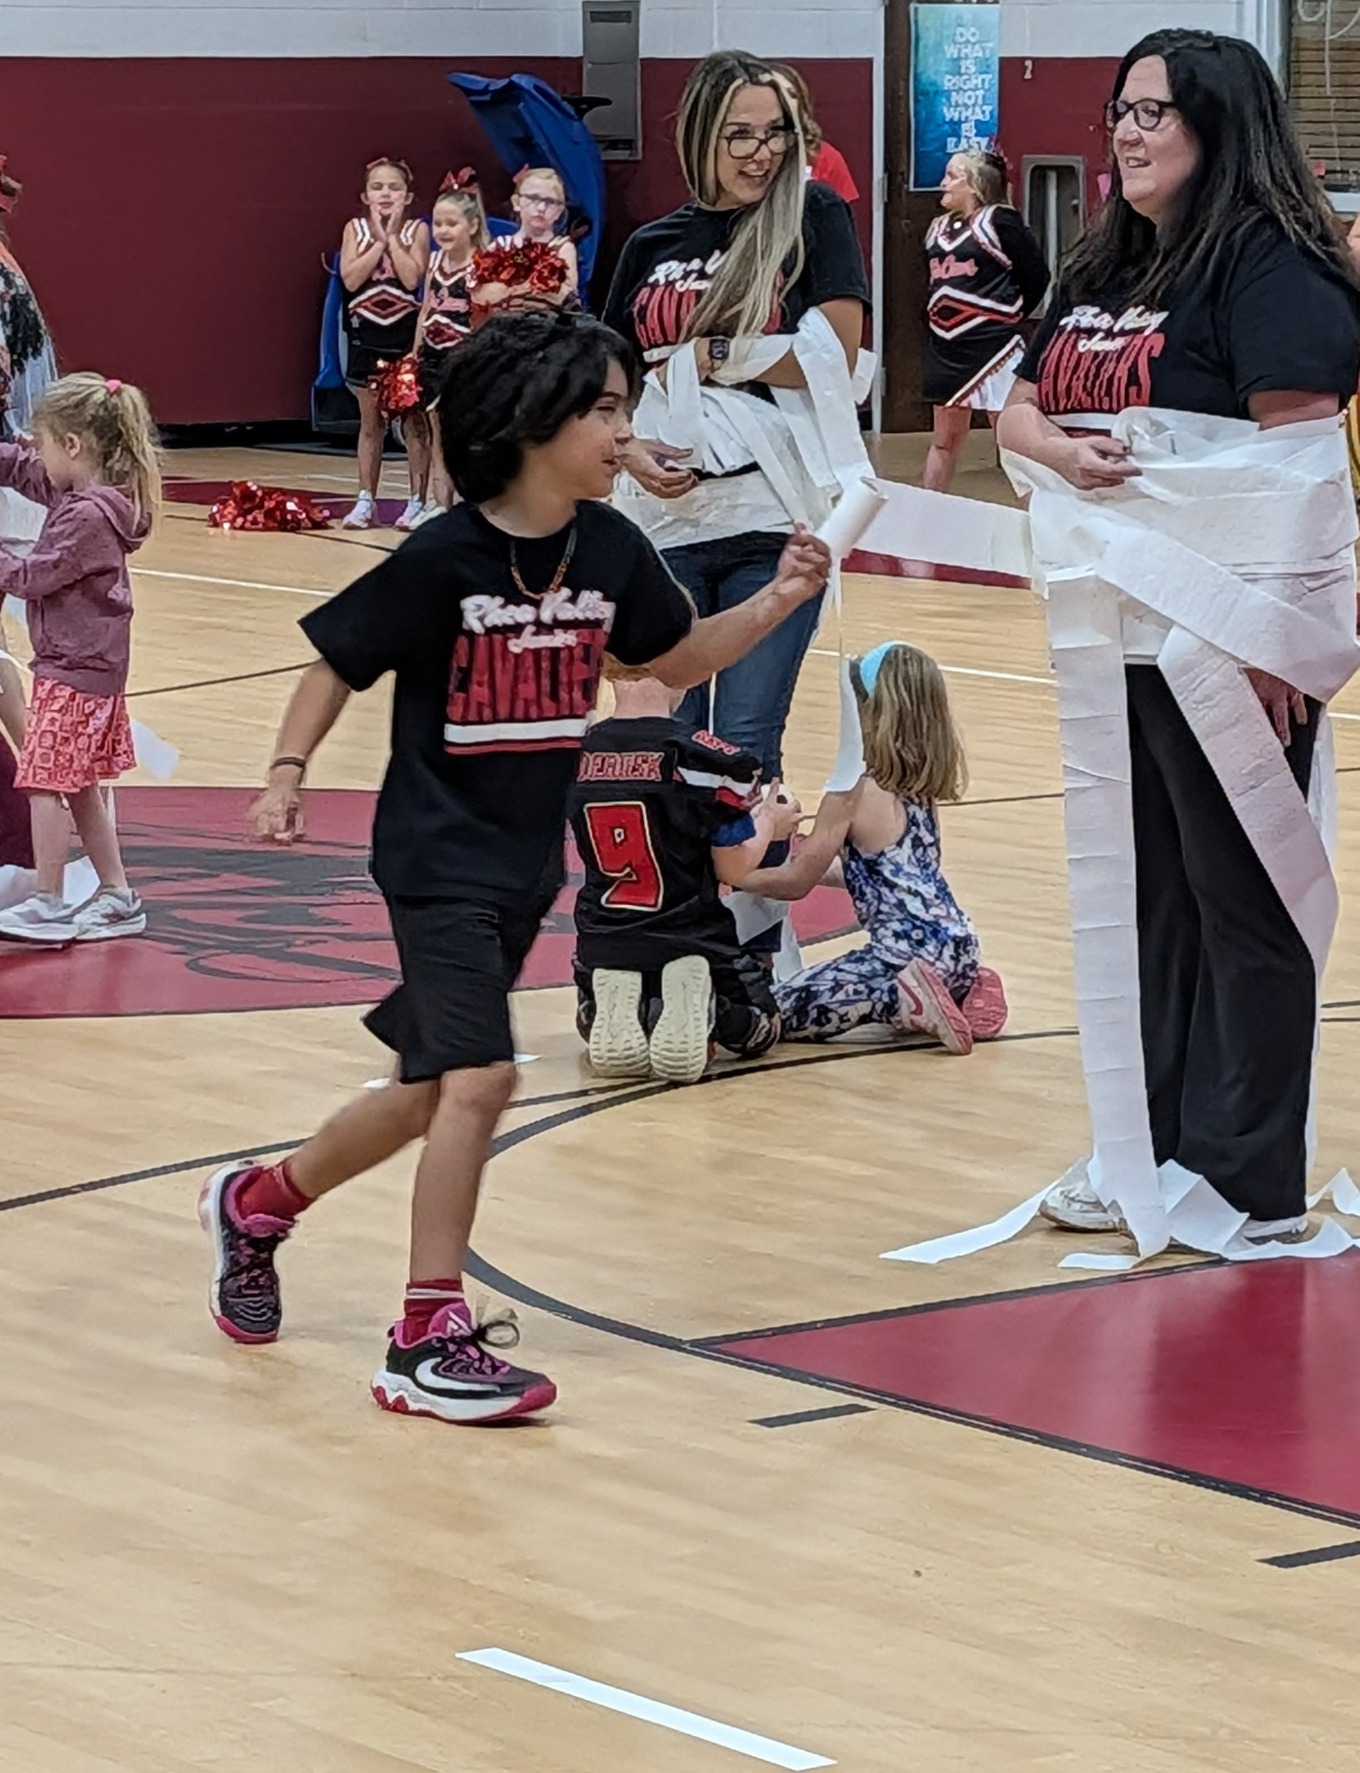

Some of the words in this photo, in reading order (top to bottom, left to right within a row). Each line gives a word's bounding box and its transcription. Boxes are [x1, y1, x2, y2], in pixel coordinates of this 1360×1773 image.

[955, 27, 980, 43] DO
[944, 42, 993, 59] WHAT
[960, 59, 977, 74] IS
[943, 74, 992, 90] RIGHT
[950, 90, 985, 106] NOT
[943, 105, 993, 122] WHAT
[583, 801, 664, 912] 9
